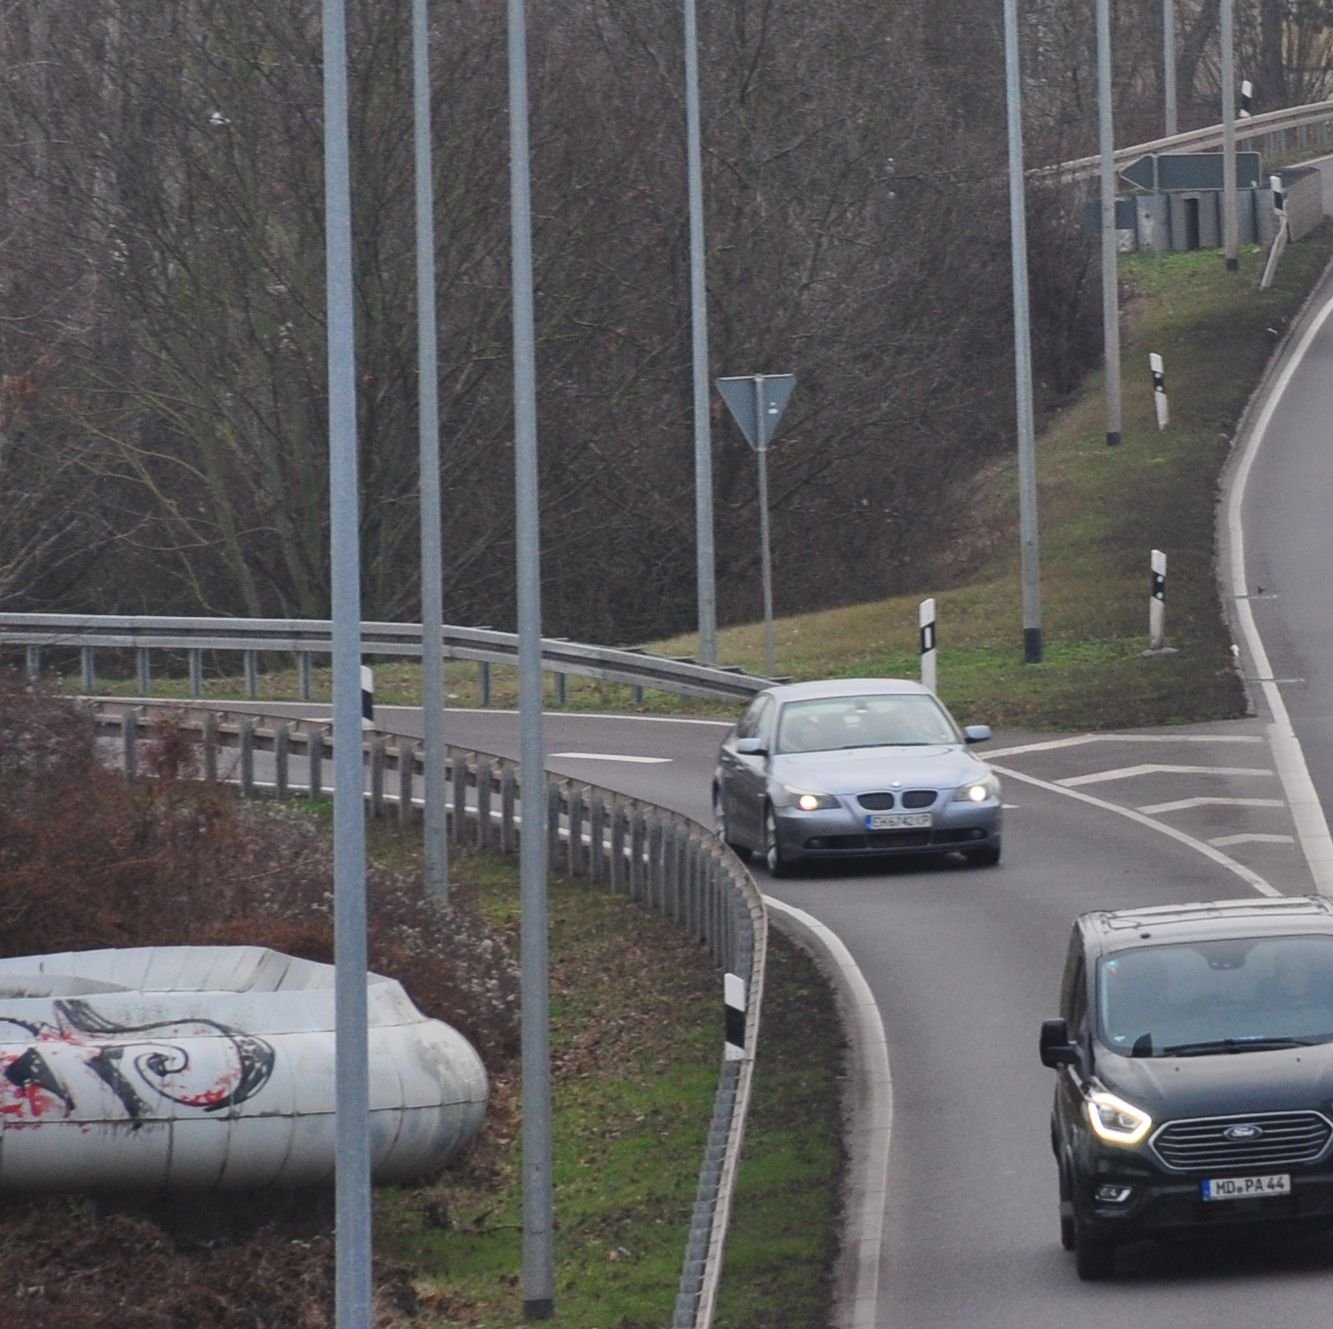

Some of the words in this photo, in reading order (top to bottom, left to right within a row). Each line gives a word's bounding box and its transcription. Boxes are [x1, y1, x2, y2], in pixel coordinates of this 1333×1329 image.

[1216, 1180, 1235, 1195] MD
[1245, 1178, 1263, 1192] PA
[1267, 1176, 1284, 1191] 44
